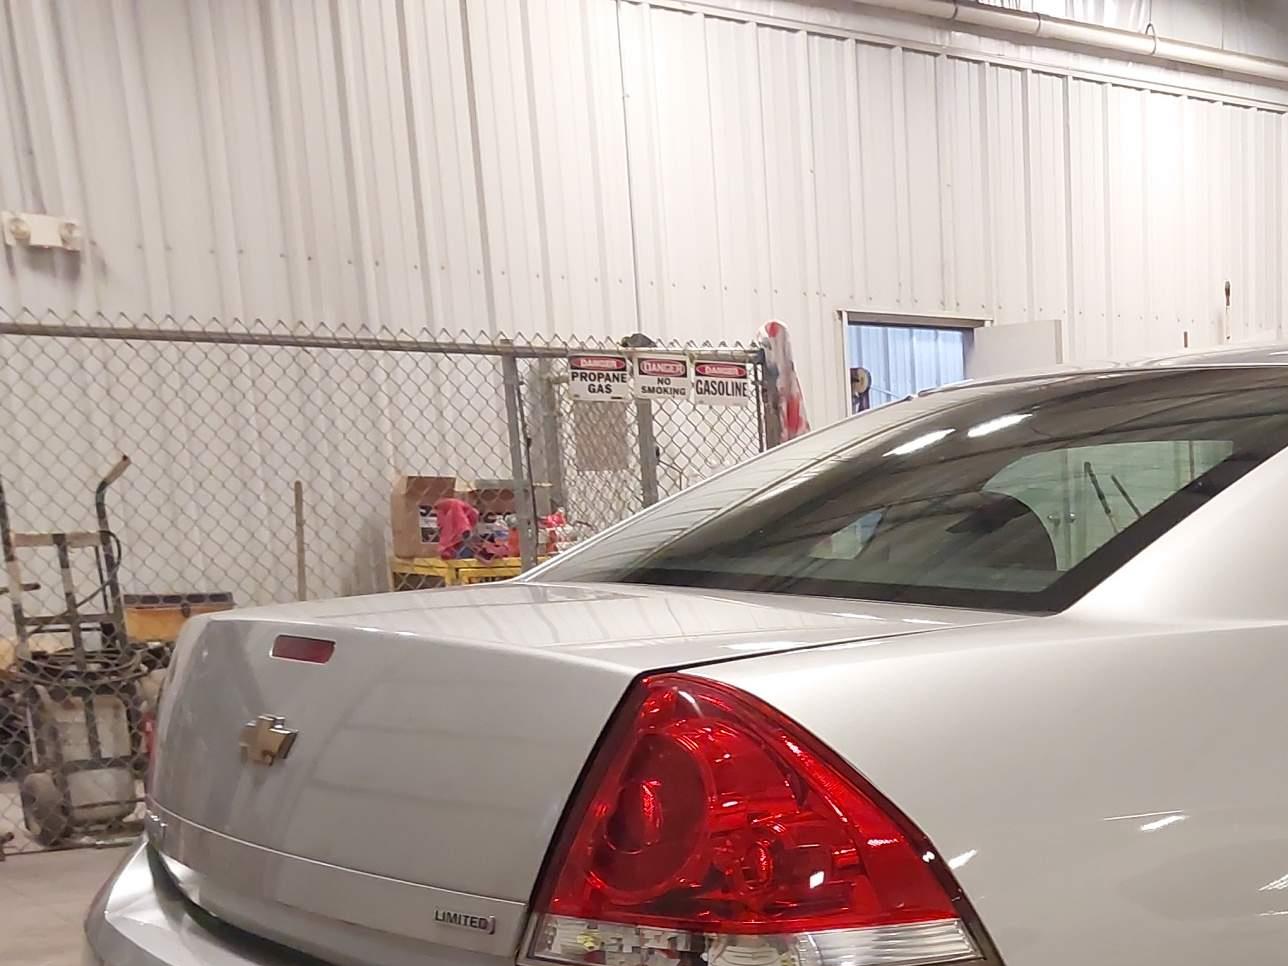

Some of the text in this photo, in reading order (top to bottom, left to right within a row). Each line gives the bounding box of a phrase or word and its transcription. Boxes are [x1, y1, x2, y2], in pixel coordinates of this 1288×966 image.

[642, 361, 684, 375] DANGER
[571, 372, 627, 383] PROPANE
[656, 377, 671, 386] NO
[588, 384, 612, 394] GAS
[641, 386, 686, 395] SMOKING
[695, 379, 748, 397] GASOLINE
[435, 909, 489, 930] LIMITED
